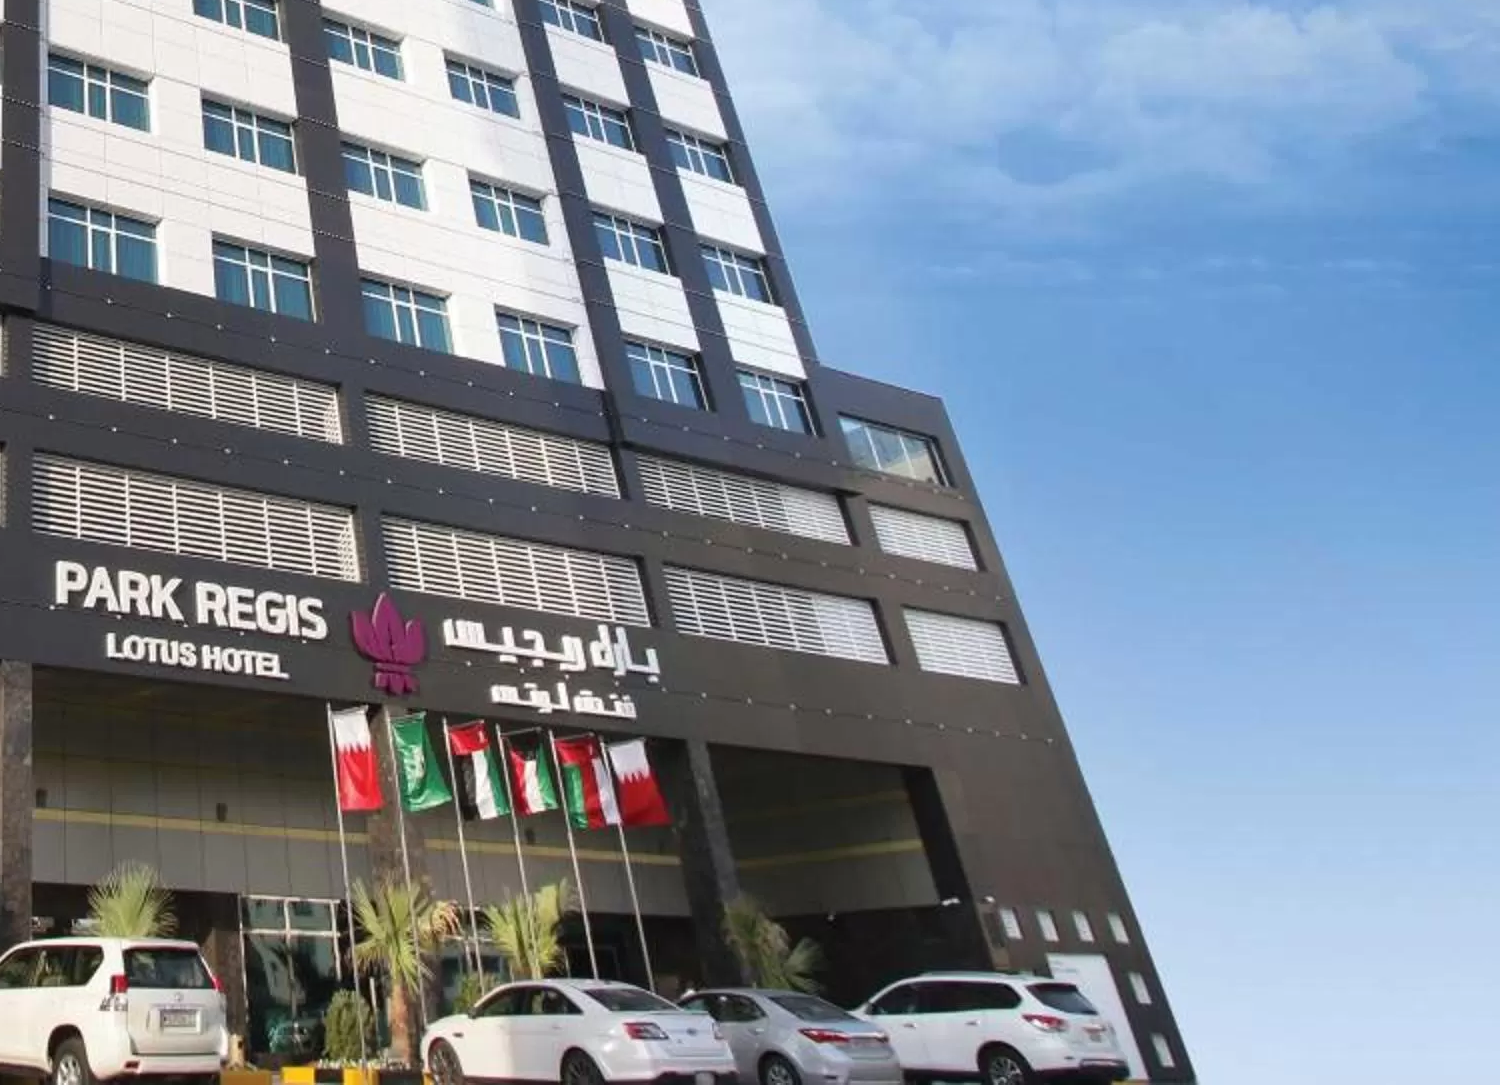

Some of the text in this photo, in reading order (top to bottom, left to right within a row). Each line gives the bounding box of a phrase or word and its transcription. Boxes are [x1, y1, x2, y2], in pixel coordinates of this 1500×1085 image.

[55, 560, 328, 640] PARK REGIS
[105, 632, 290, 680] LOTUS HOTEL
